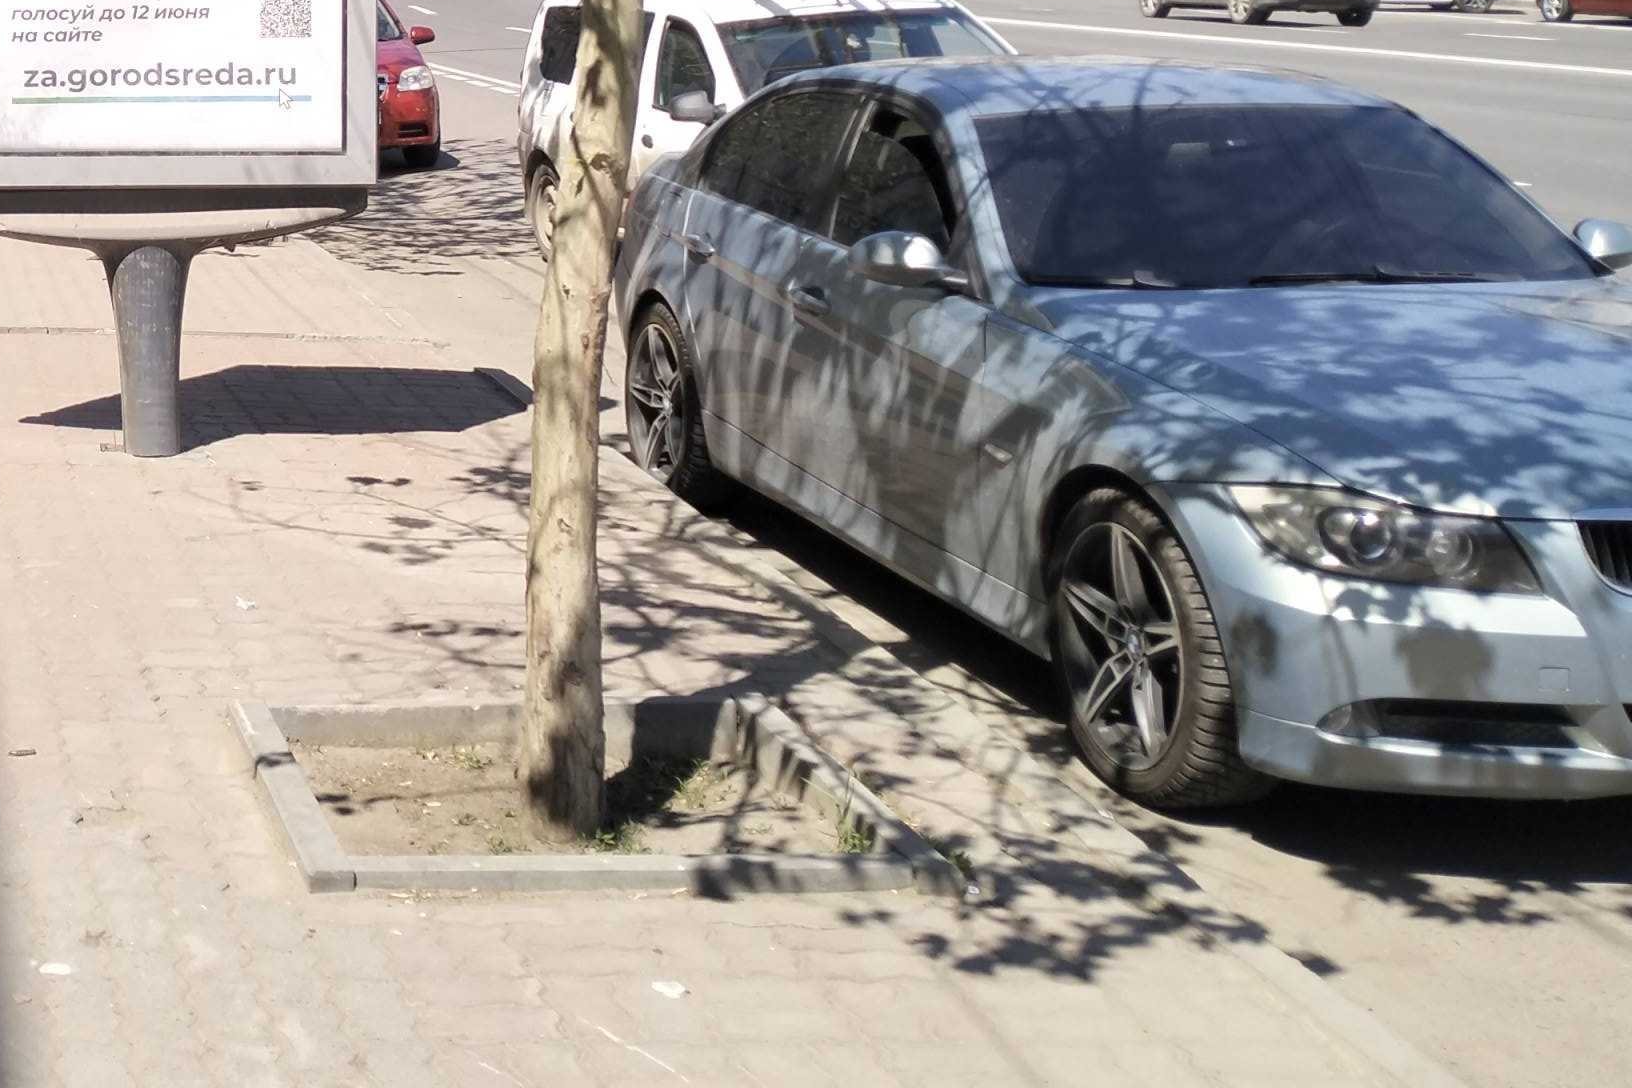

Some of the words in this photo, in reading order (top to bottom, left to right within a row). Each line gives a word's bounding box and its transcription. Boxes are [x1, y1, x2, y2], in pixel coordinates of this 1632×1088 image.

[11, 4, 95, 24] голосуй
[99, 7, 126, 22] до
[131, 5, 150, 19] 12
[154, 7, 210, 20] июня
[11, 30, 38, 43] на
[43, 26, 104, 42] сайте
[23, 62, 298, 93] za.gorodsreda.ru
